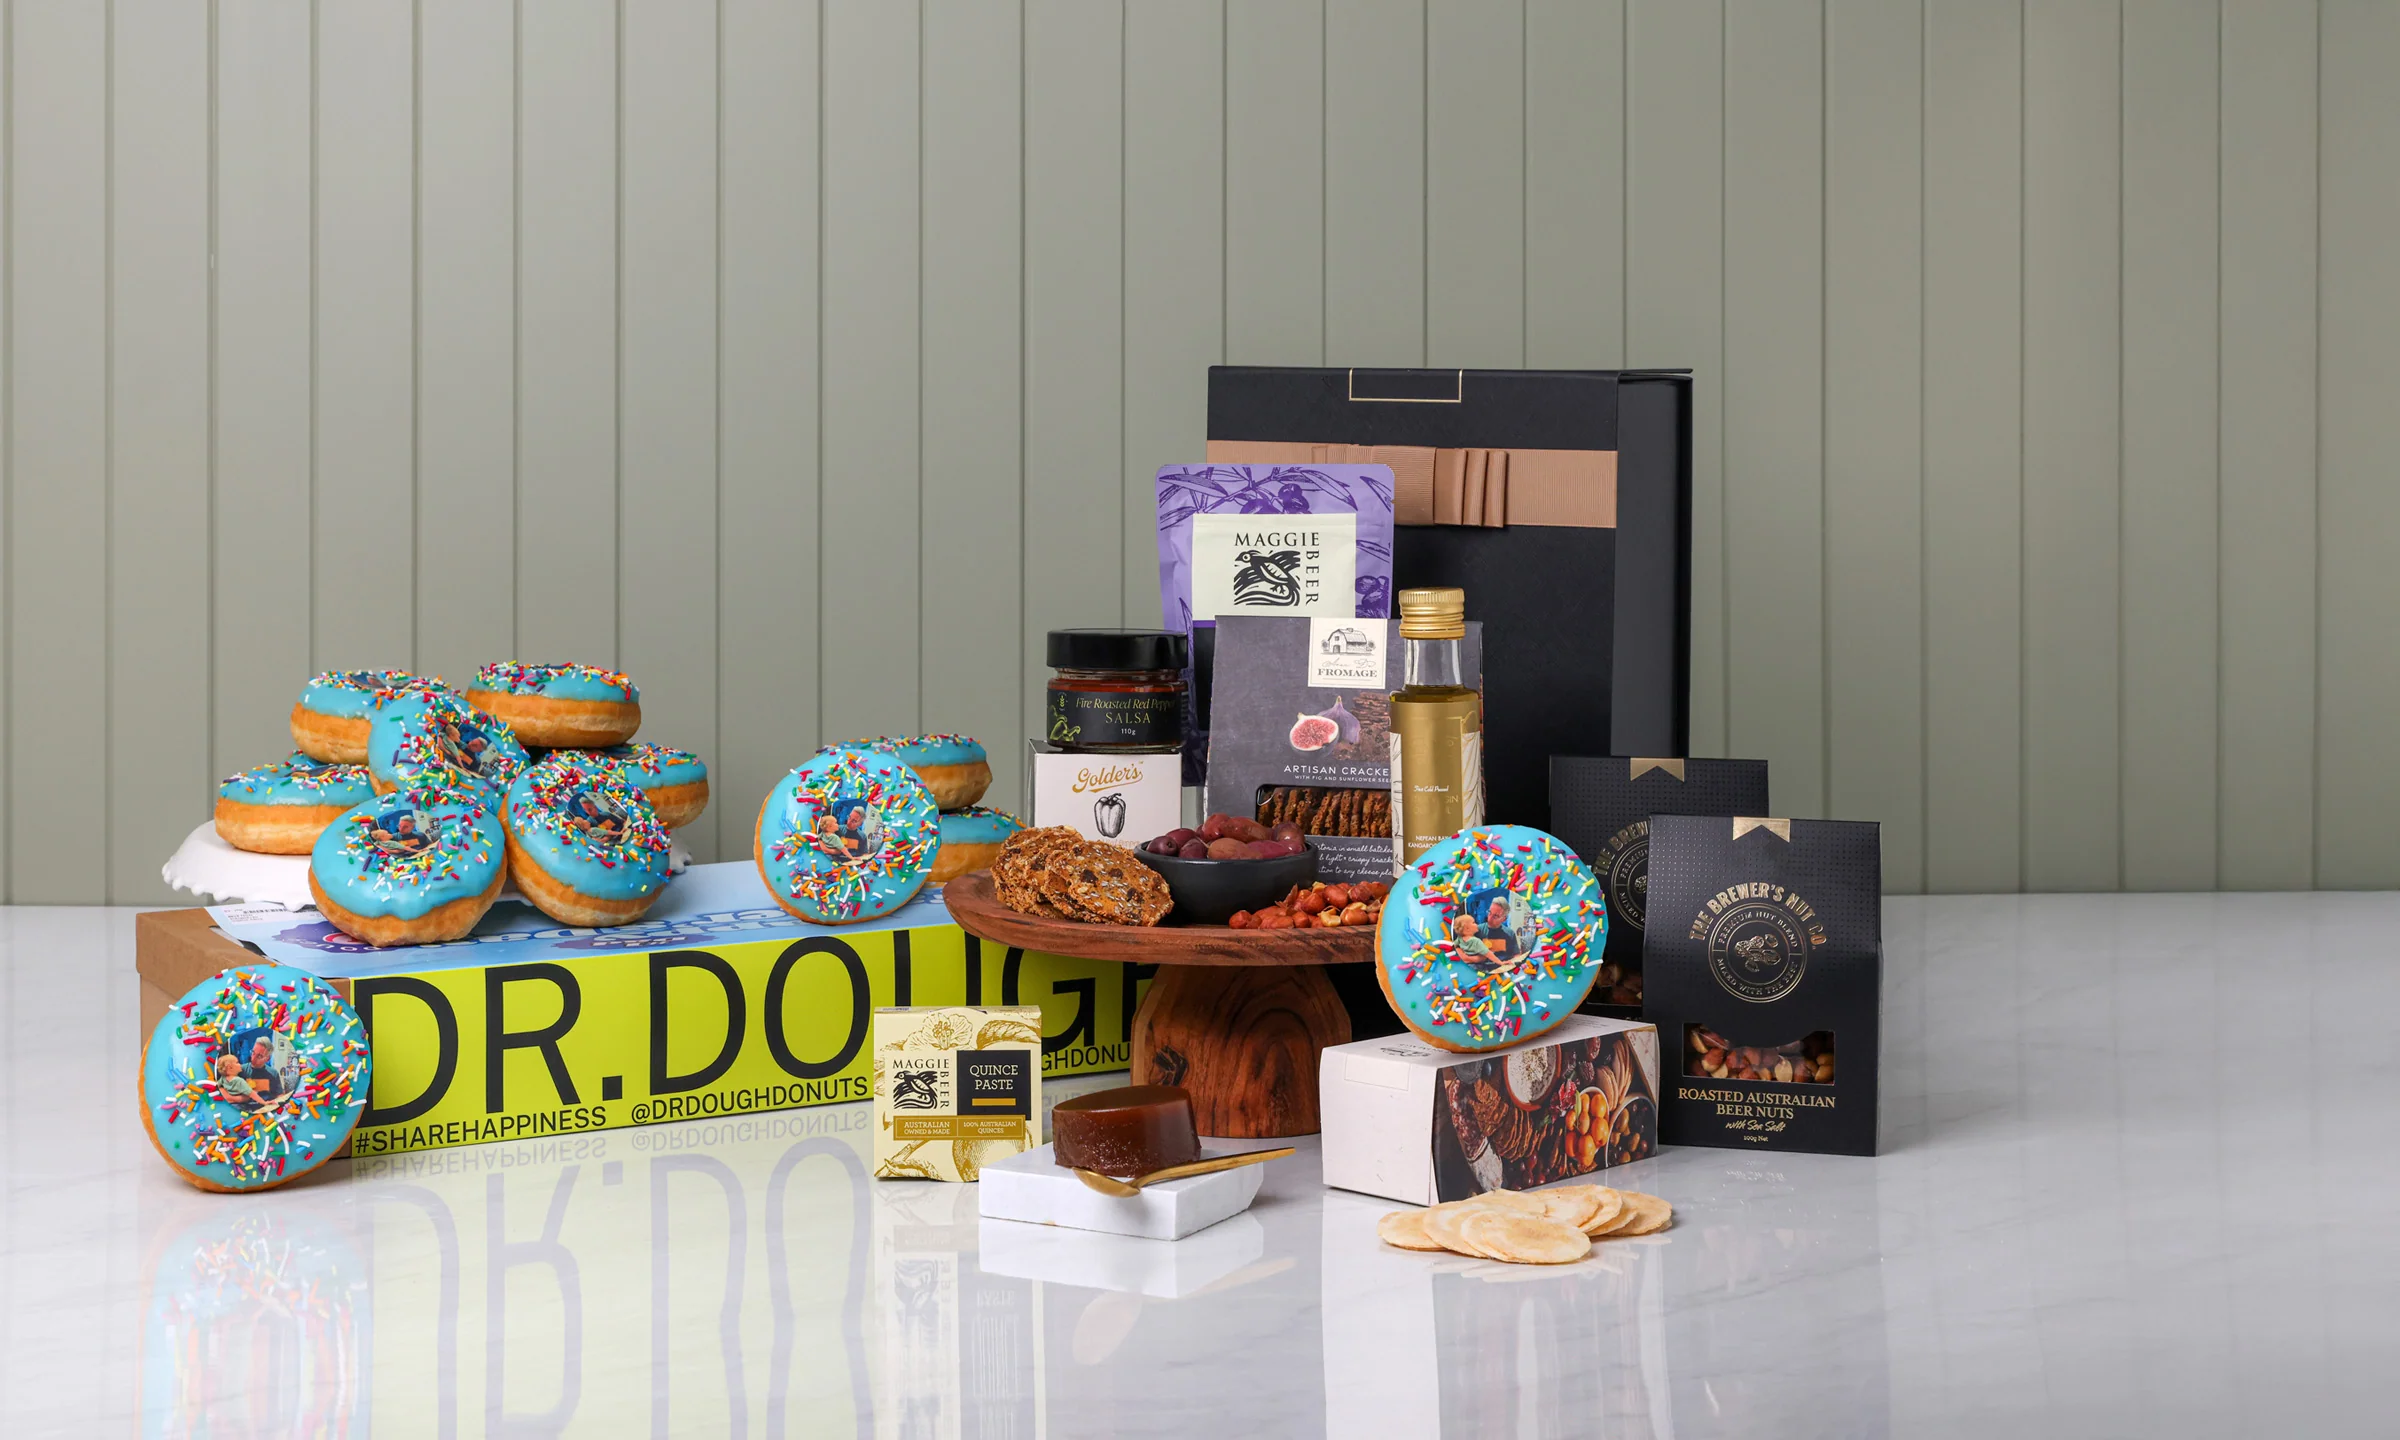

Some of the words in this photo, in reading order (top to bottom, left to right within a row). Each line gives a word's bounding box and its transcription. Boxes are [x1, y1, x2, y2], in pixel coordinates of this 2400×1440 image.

[1234, 532, 1320, 547] MAGGIE
[1305, 550, 1320, 605] BEER
[1317, 668, 1378, 678] FROMAGE
[1075, 697, 1092, 708] Fire
[1094, 698, 1131, 709] Roasted
[1133, 698, 1149, 709] Red
[1105, 712, 1151, 724] SALSA
[1121, 728, 1136, 736] 110g
[1283, 765, 1337, 775] ARTISAN
[1341, 767, 1390, 777] CRACKE
[1072, 763, 1143, 793] Golder's
[1609, 820, 1649, 851] BREW
[1346, 845, 1369, 853] small
[1326, 854, 1344, 865] light
[1348, 856, 1370, 866] crispy
[1343, 868, 1355, 878] any
[1357, 867, 1380, 875] cheese
[1689, 910, 1714, 940] THE
[1706, 882, 1785, 915] BREWER'S
[1784, 892, 1816, 922] NUT
[1717, 911, 1753, 944] PREMIUM
[1755, 911, 1777, 921] NUT
[1777, 919, 1798, 948] BLEND
[1717, 958, 1738, 986] MIXED
[1739, 983, 1763, 996] WITH
[1766, 983, 1785, 995] THE
[892, 1058, 950, 1069] MAGGIE
[969, 1064, 1019, 1077] QUINCE
[940, 1071, 950, 1108] BEER
[975, 1079, 1014, 1090] PASTE
[1678, 1087, 1744, 1103] ROASTED
[1747, 1092, 1836, 1108] AUSTRALIAN
[355, 1105, 607, 1154] #SHAREHAPPINESS
[631, 1076, 868, 1124] @DRDOUGHDONUTS
[1716, 1103, 1753, 1118] BEER
[1756, 1105, 1794, 1120] NUTS
[904, 1121, 951, 1129] AUSTRALIAN
[1725, 1119, 1746, 1130] with
[1747, 1120, 1763, 1131] Sea
[1764, 1121, 1787, 1132] Salt
